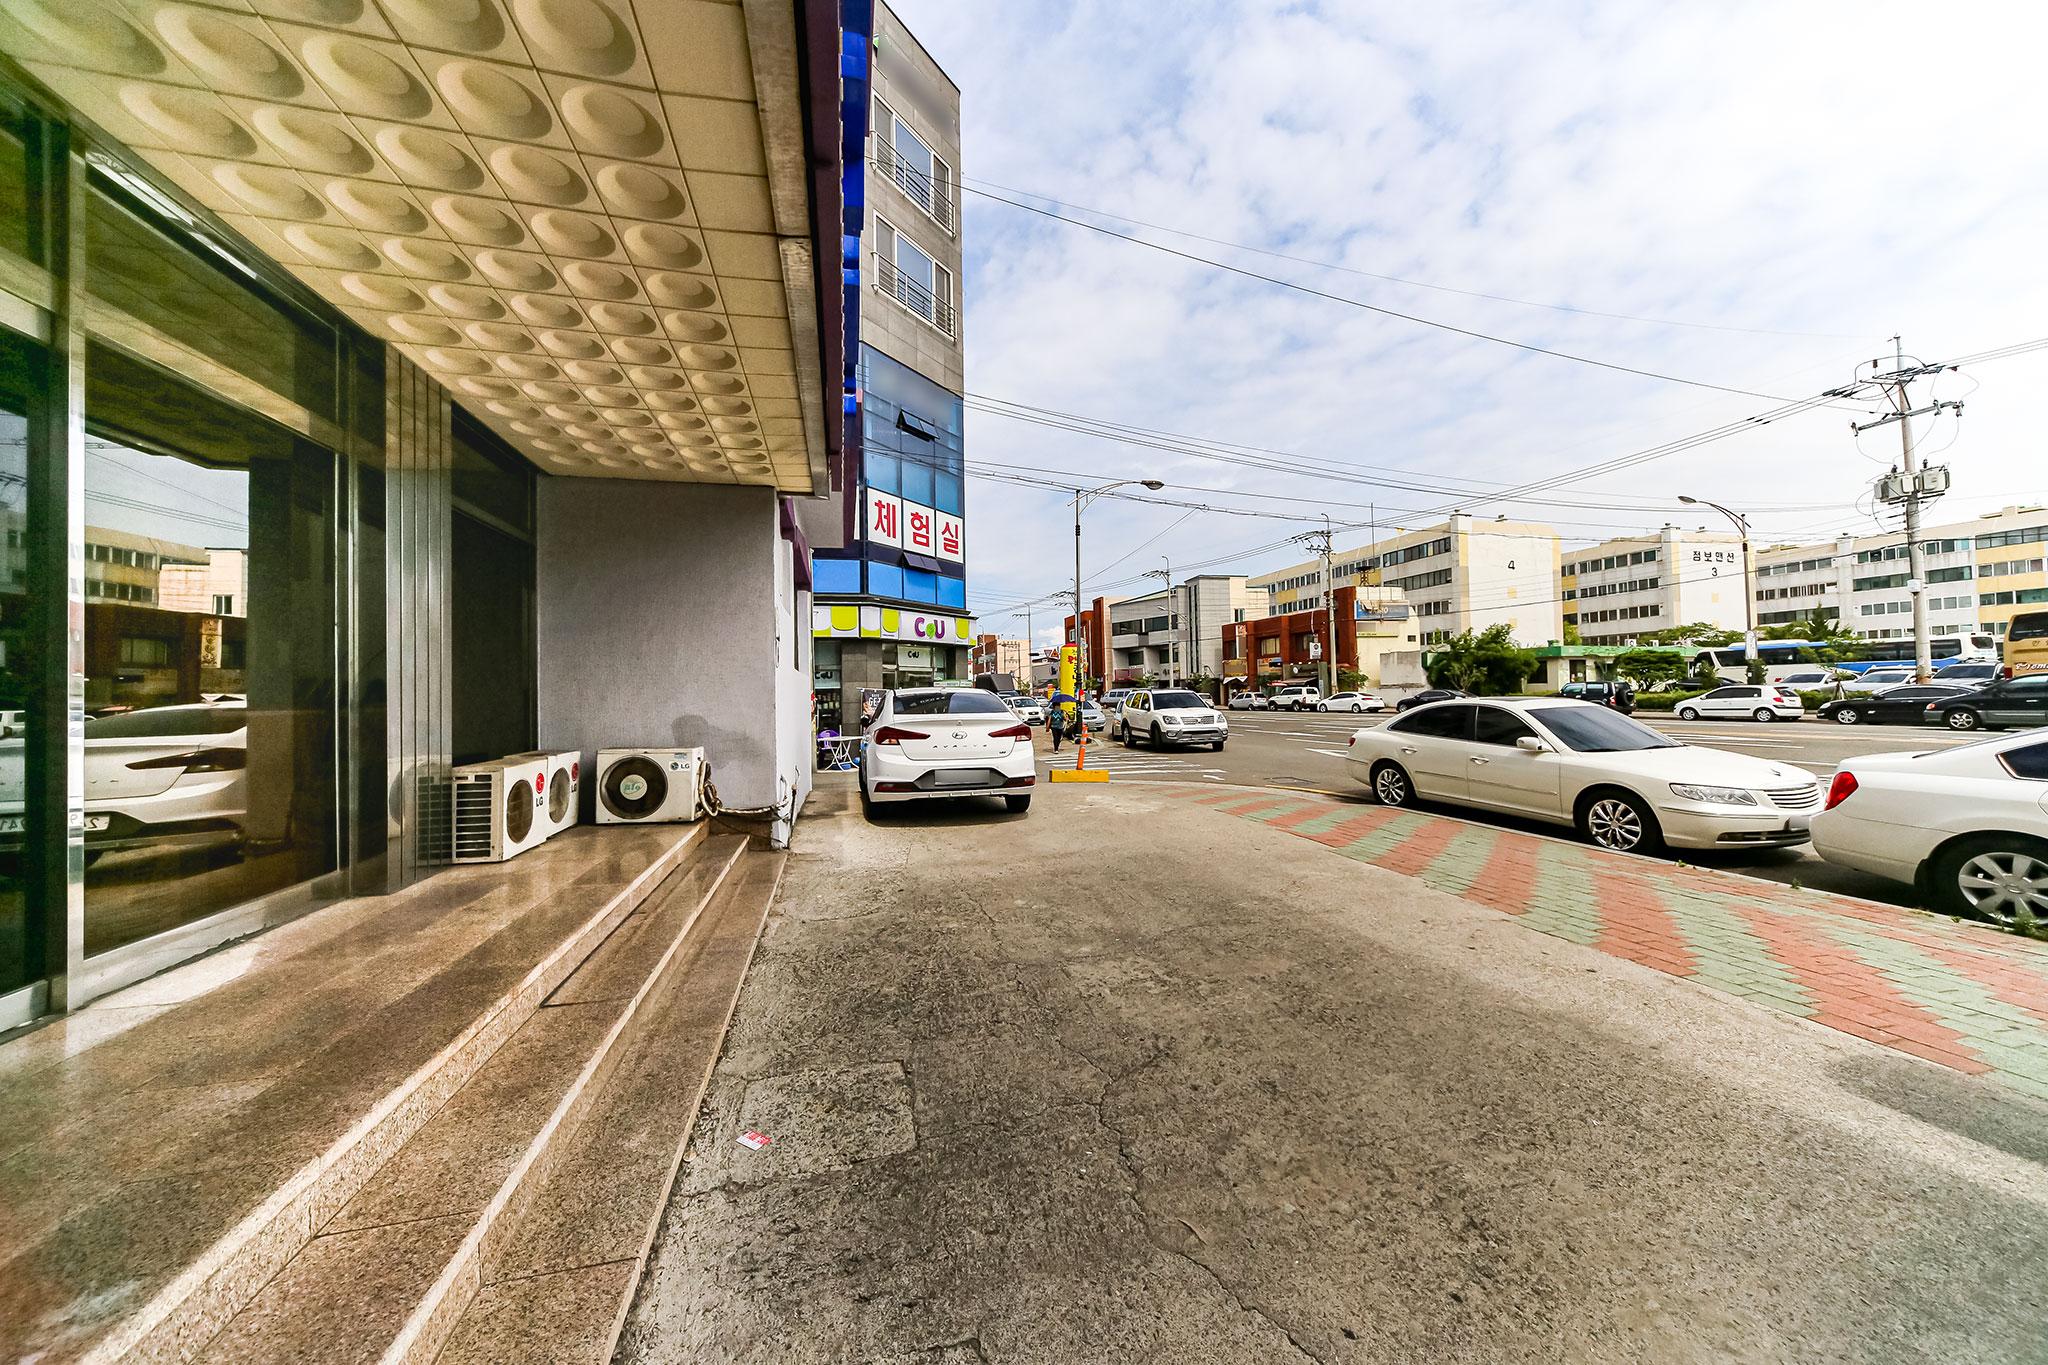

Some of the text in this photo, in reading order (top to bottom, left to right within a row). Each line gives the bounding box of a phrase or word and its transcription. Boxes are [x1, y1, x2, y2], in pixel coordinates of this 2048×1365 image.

[873, 499, 959, 555] 체험실
[1507, 560, 1516, 571] 4
[1711, 566, 1718, 577] 3
[914, 616, 946, 639] CU
[570, 783, 577, 793] LG
[535, 797, 544, 807] LG
